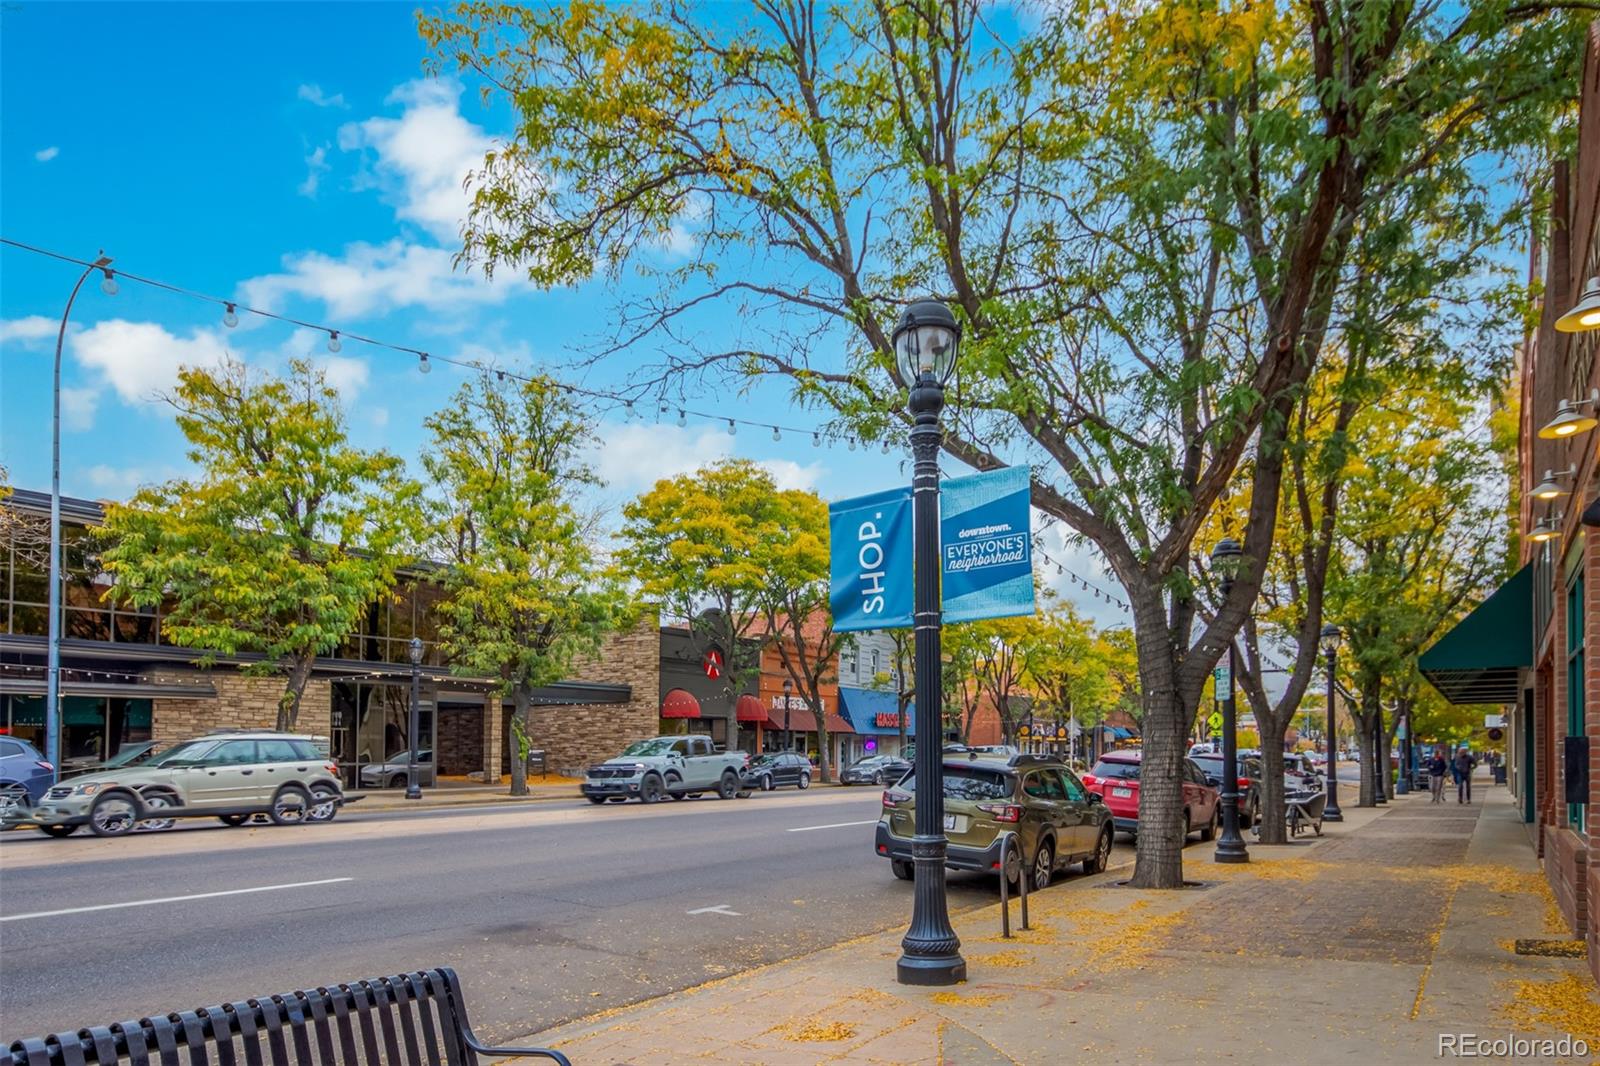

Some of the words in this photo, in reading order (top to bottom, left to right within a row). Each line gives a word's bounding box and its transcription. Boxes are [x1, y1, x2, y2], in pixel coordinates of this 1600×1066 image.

[958, 523, 1012, 538] downtown.
[947, 536, 1024, 558] EVERYONE'S
[858, 511, 885, 614] SHOP.
[948, 547, 1024, 572] neighborhood
